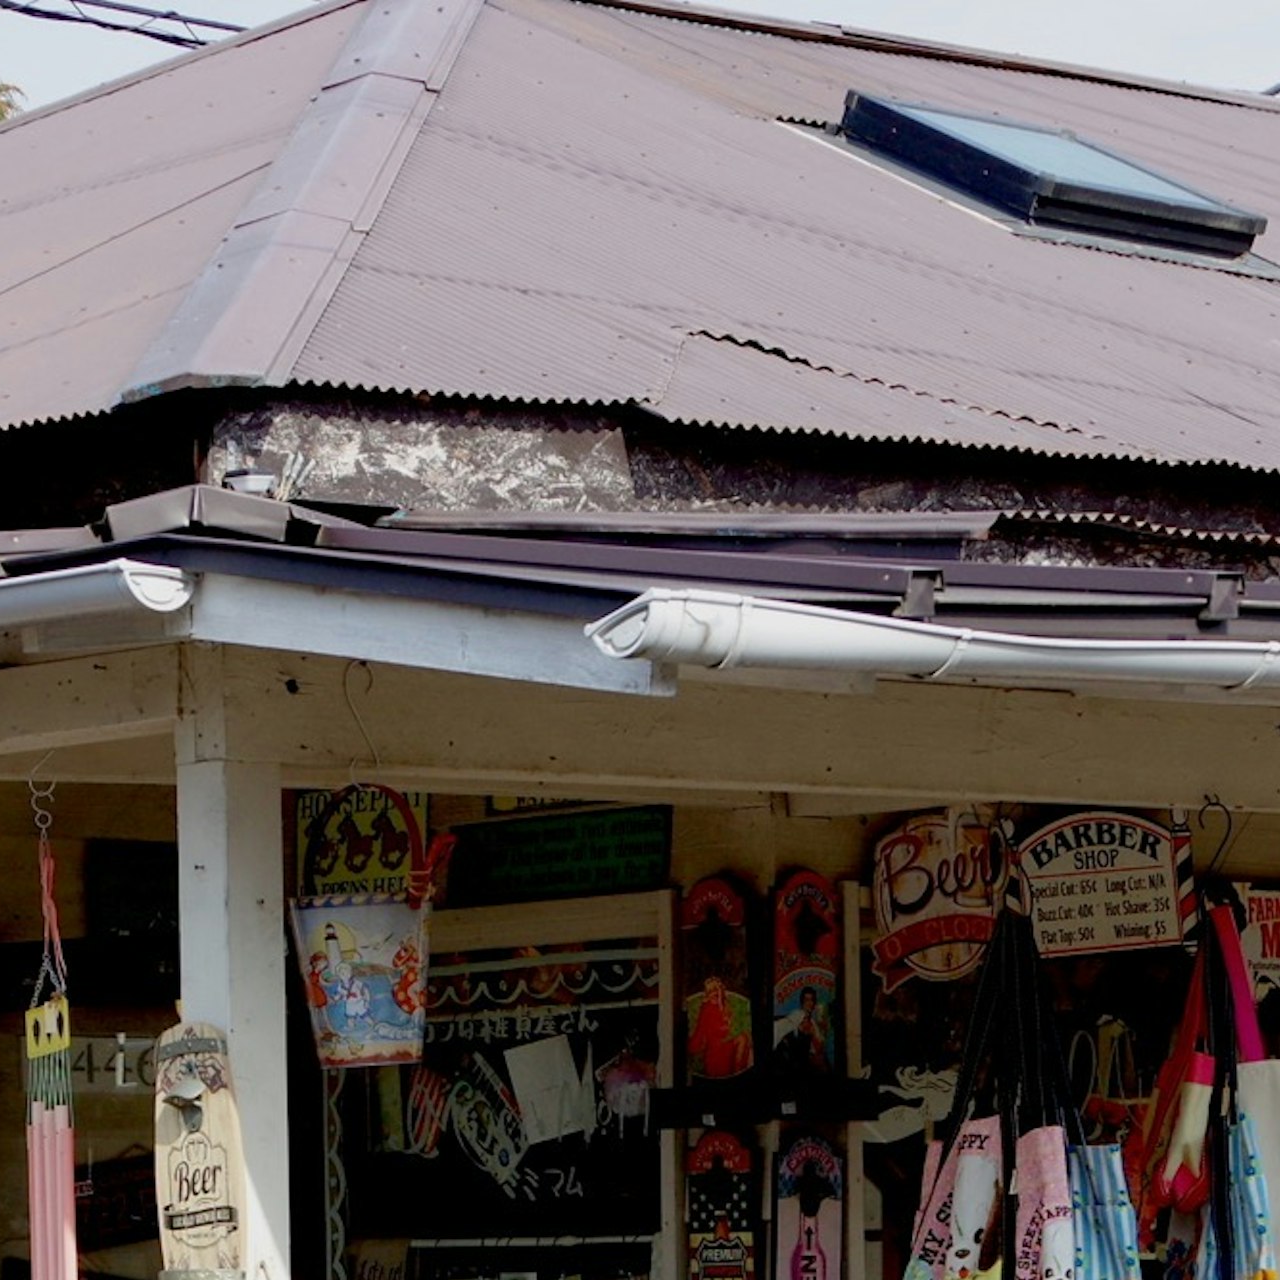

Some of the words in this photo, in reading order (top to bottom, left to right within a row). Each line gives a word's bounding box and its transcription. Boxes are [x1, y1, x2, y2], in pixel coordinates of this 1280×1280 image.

[1030, 822, 1162, 870] BARBER
[1074, 849, 1119, 870] SHOP
[884, 834, 997, 921] Beer
[1106, 878, 1127, 898] Long
[1149, 873, 1166, 889] N/A
[1037, 907, 1057, 923] Buzz
[1122, 899, 1151, 916] Shave:
[173, 1160, 222, 1203] Beer
